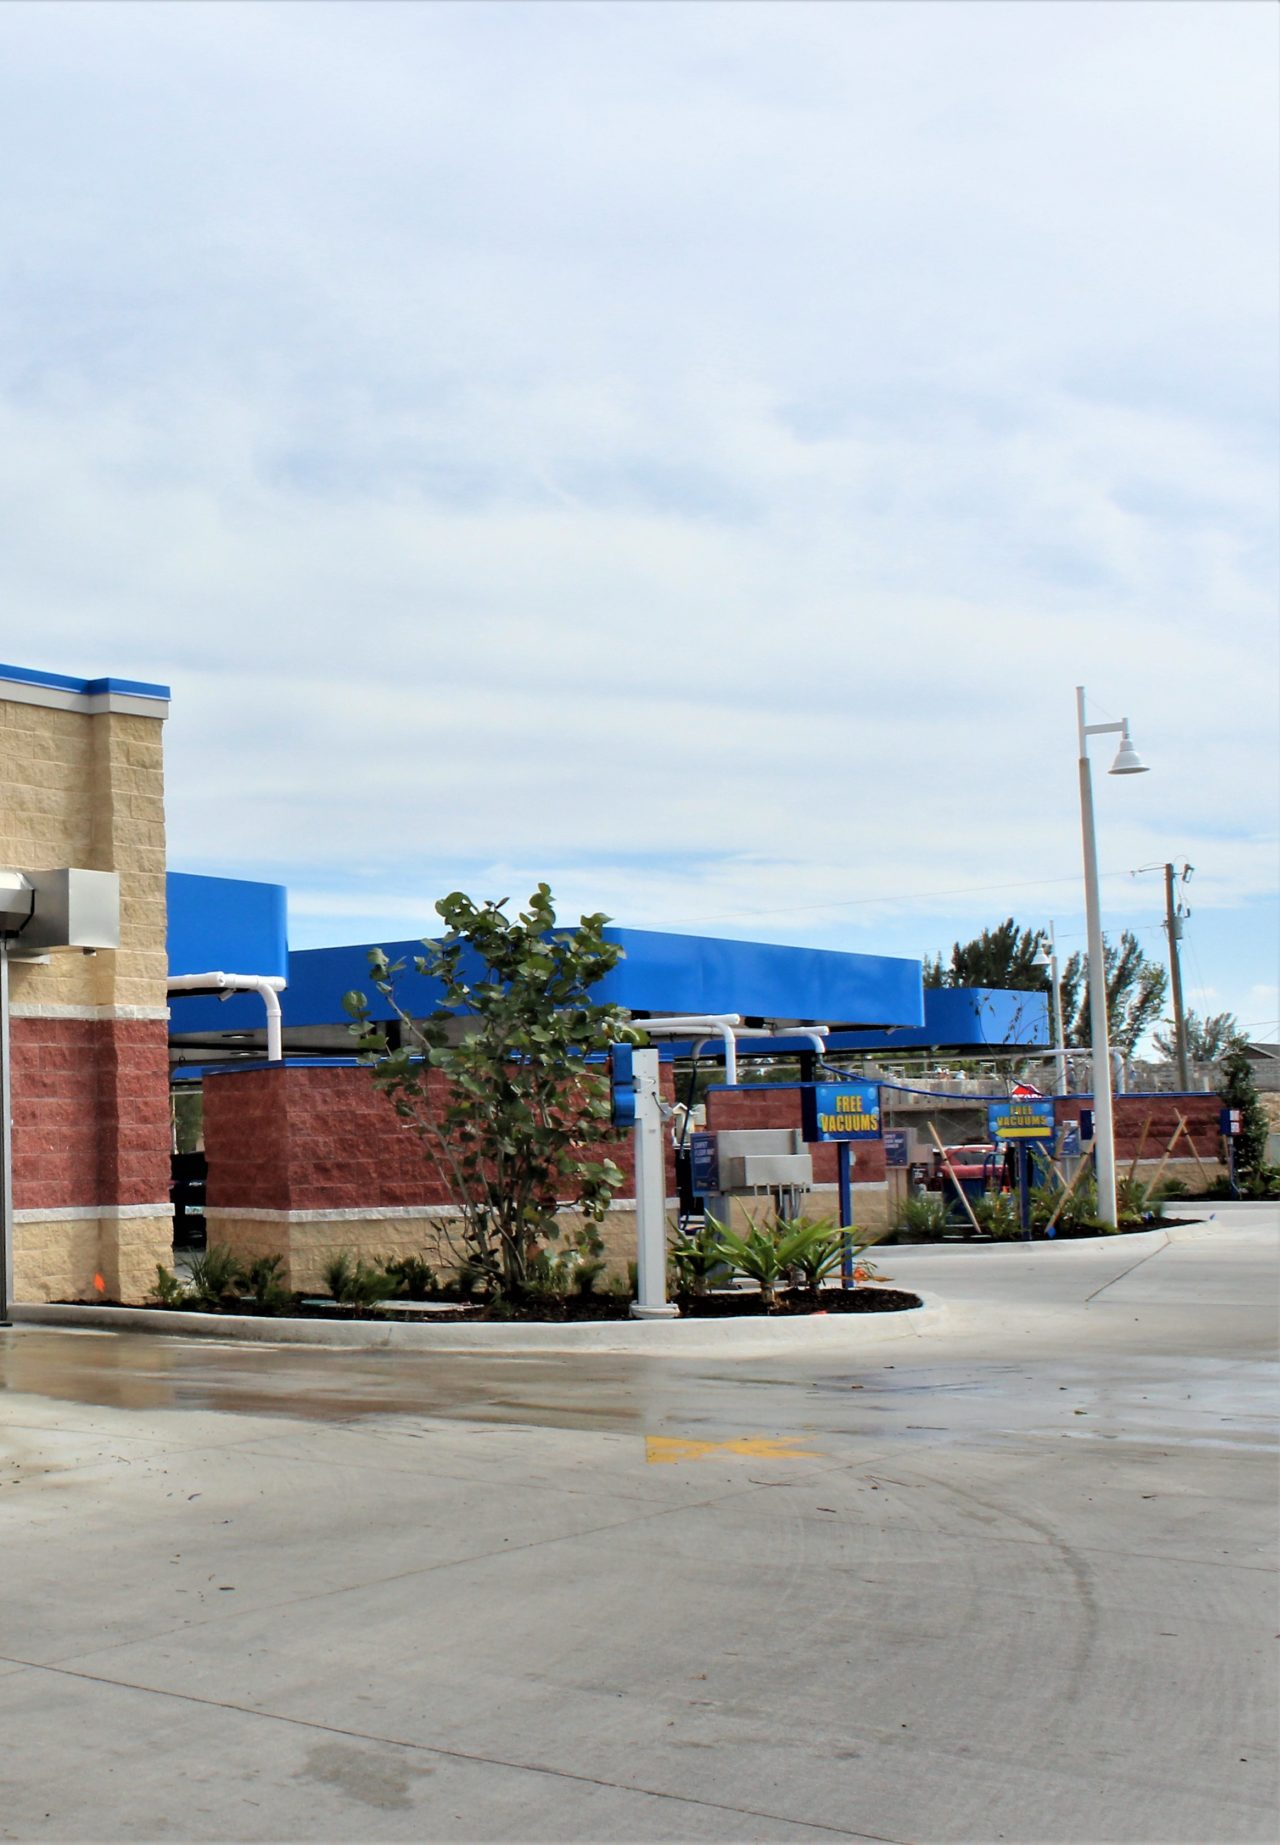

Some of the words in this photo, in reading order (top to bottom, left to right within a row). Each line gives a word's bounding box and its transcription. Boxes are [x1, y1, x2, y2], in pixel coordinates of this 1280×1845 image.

[836, 1096, 863, 1112] FREE
[1010, 1105, 1033, 1115] FREE
[821, 1114, 879, 1132] VACUUMS
[997, 1115, 1046, 1126] VACUUMS
